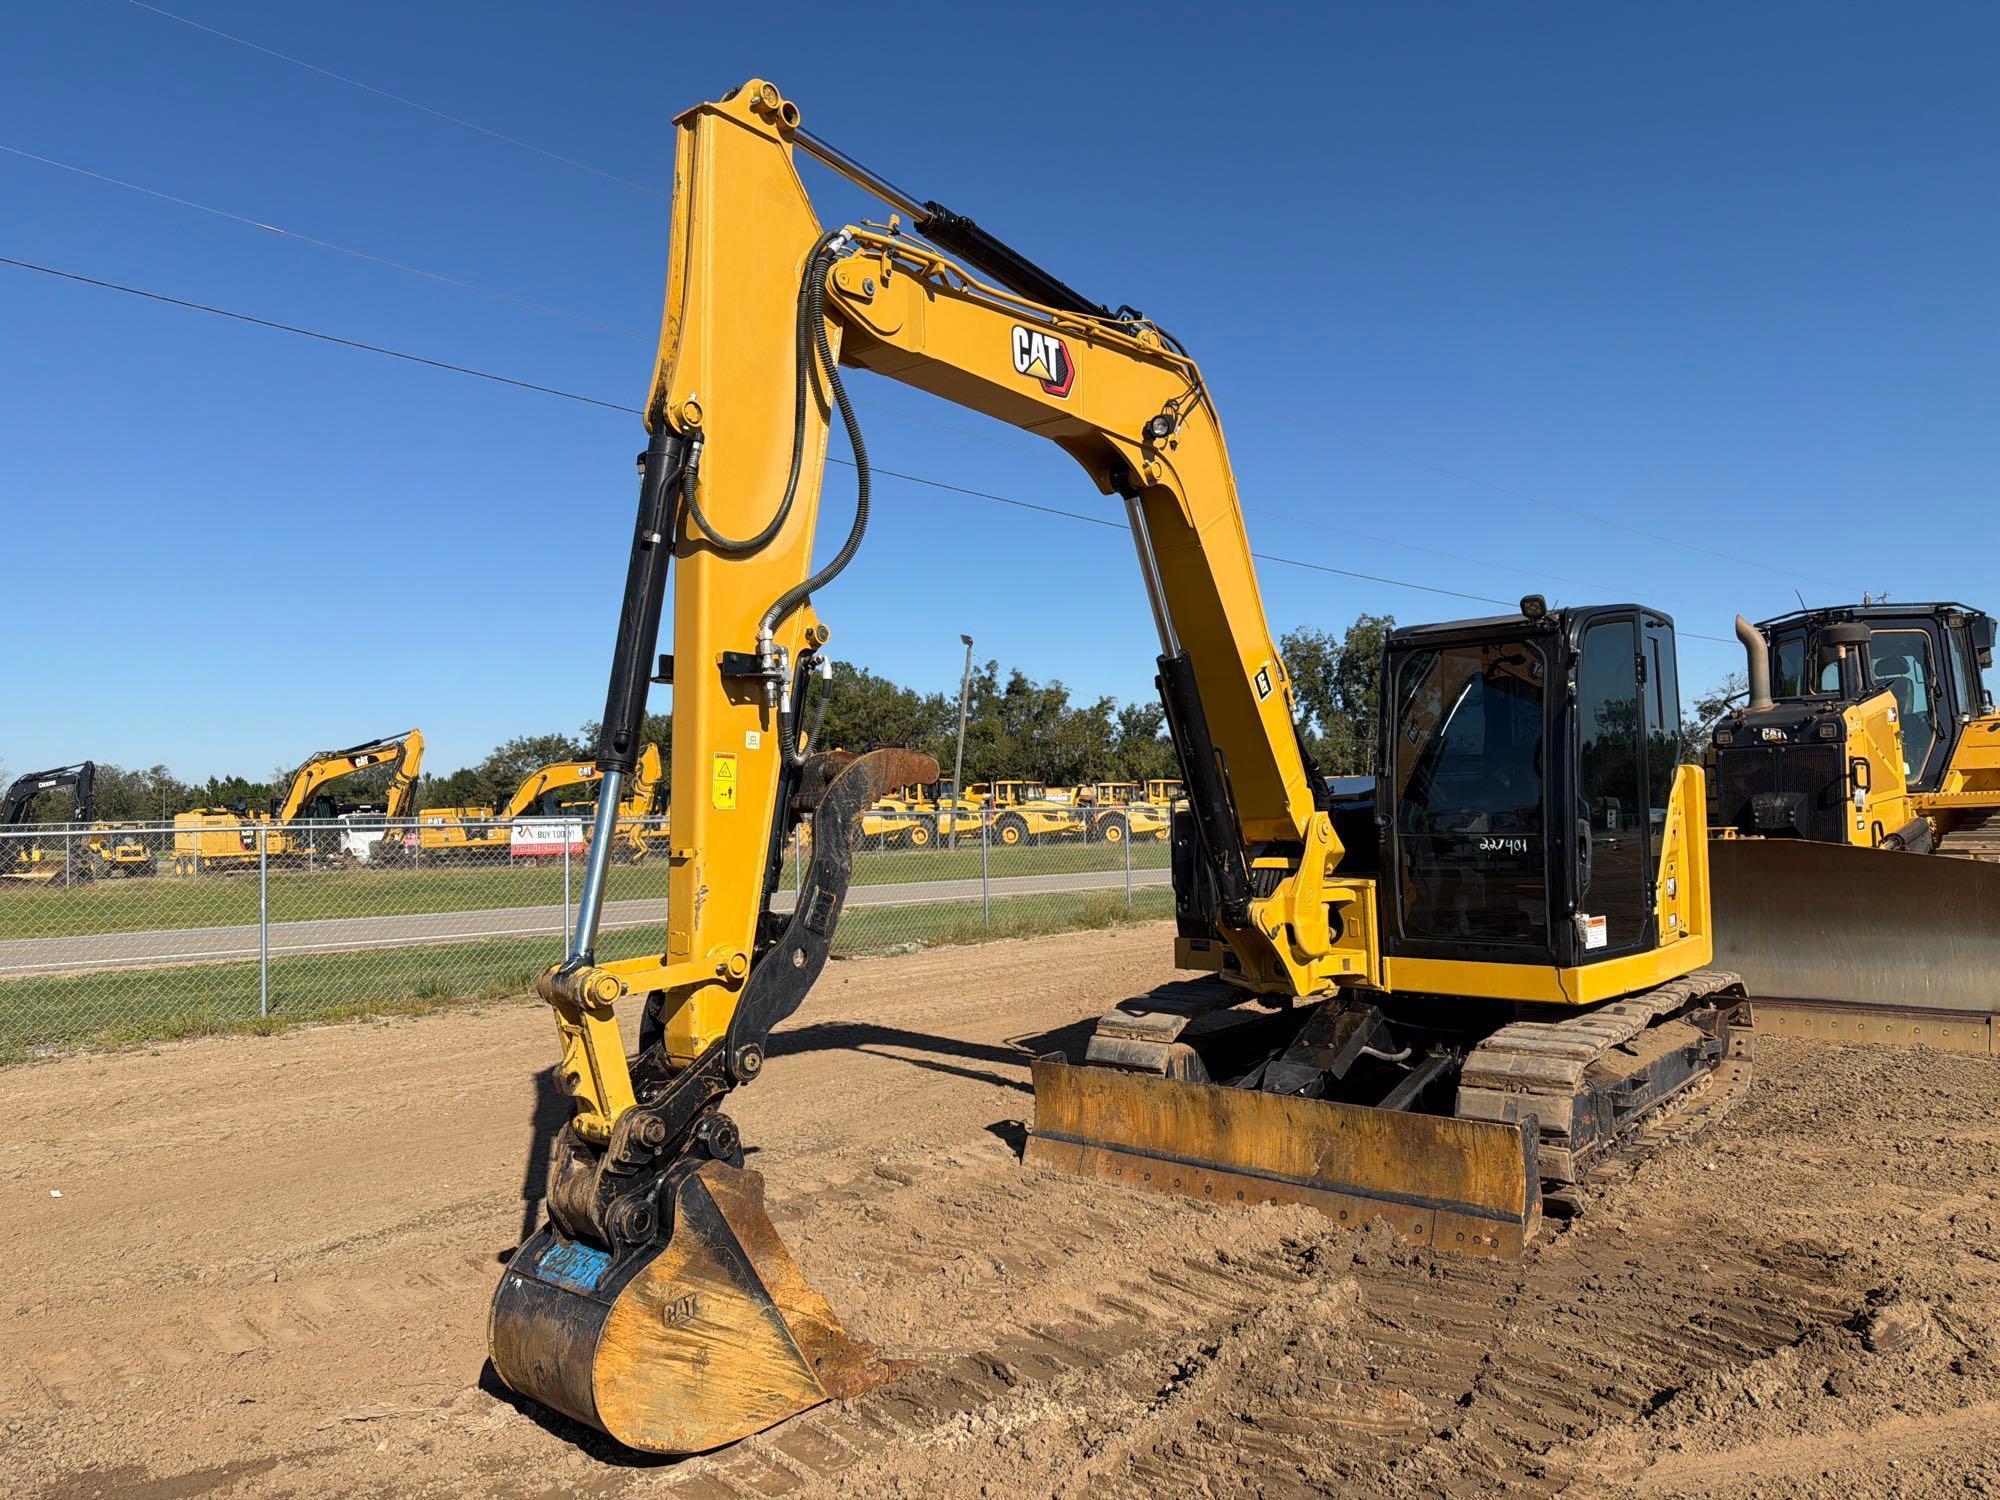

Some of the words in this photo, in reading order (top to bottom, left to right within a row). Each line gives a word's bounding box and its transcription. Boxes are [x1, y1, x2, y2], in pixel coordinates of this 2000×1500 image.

[1012, 326, 1060, 382] CAT
[1762, 728, 1782, 741] CAT
[355, 755, 369, 768] CAT
[578, 766, 592, 777] CAT
[537, 831, 551, 839] BUY
[1479, 837, 1528, 855] 227401
[663, 1293, 697, 1328] CAT
